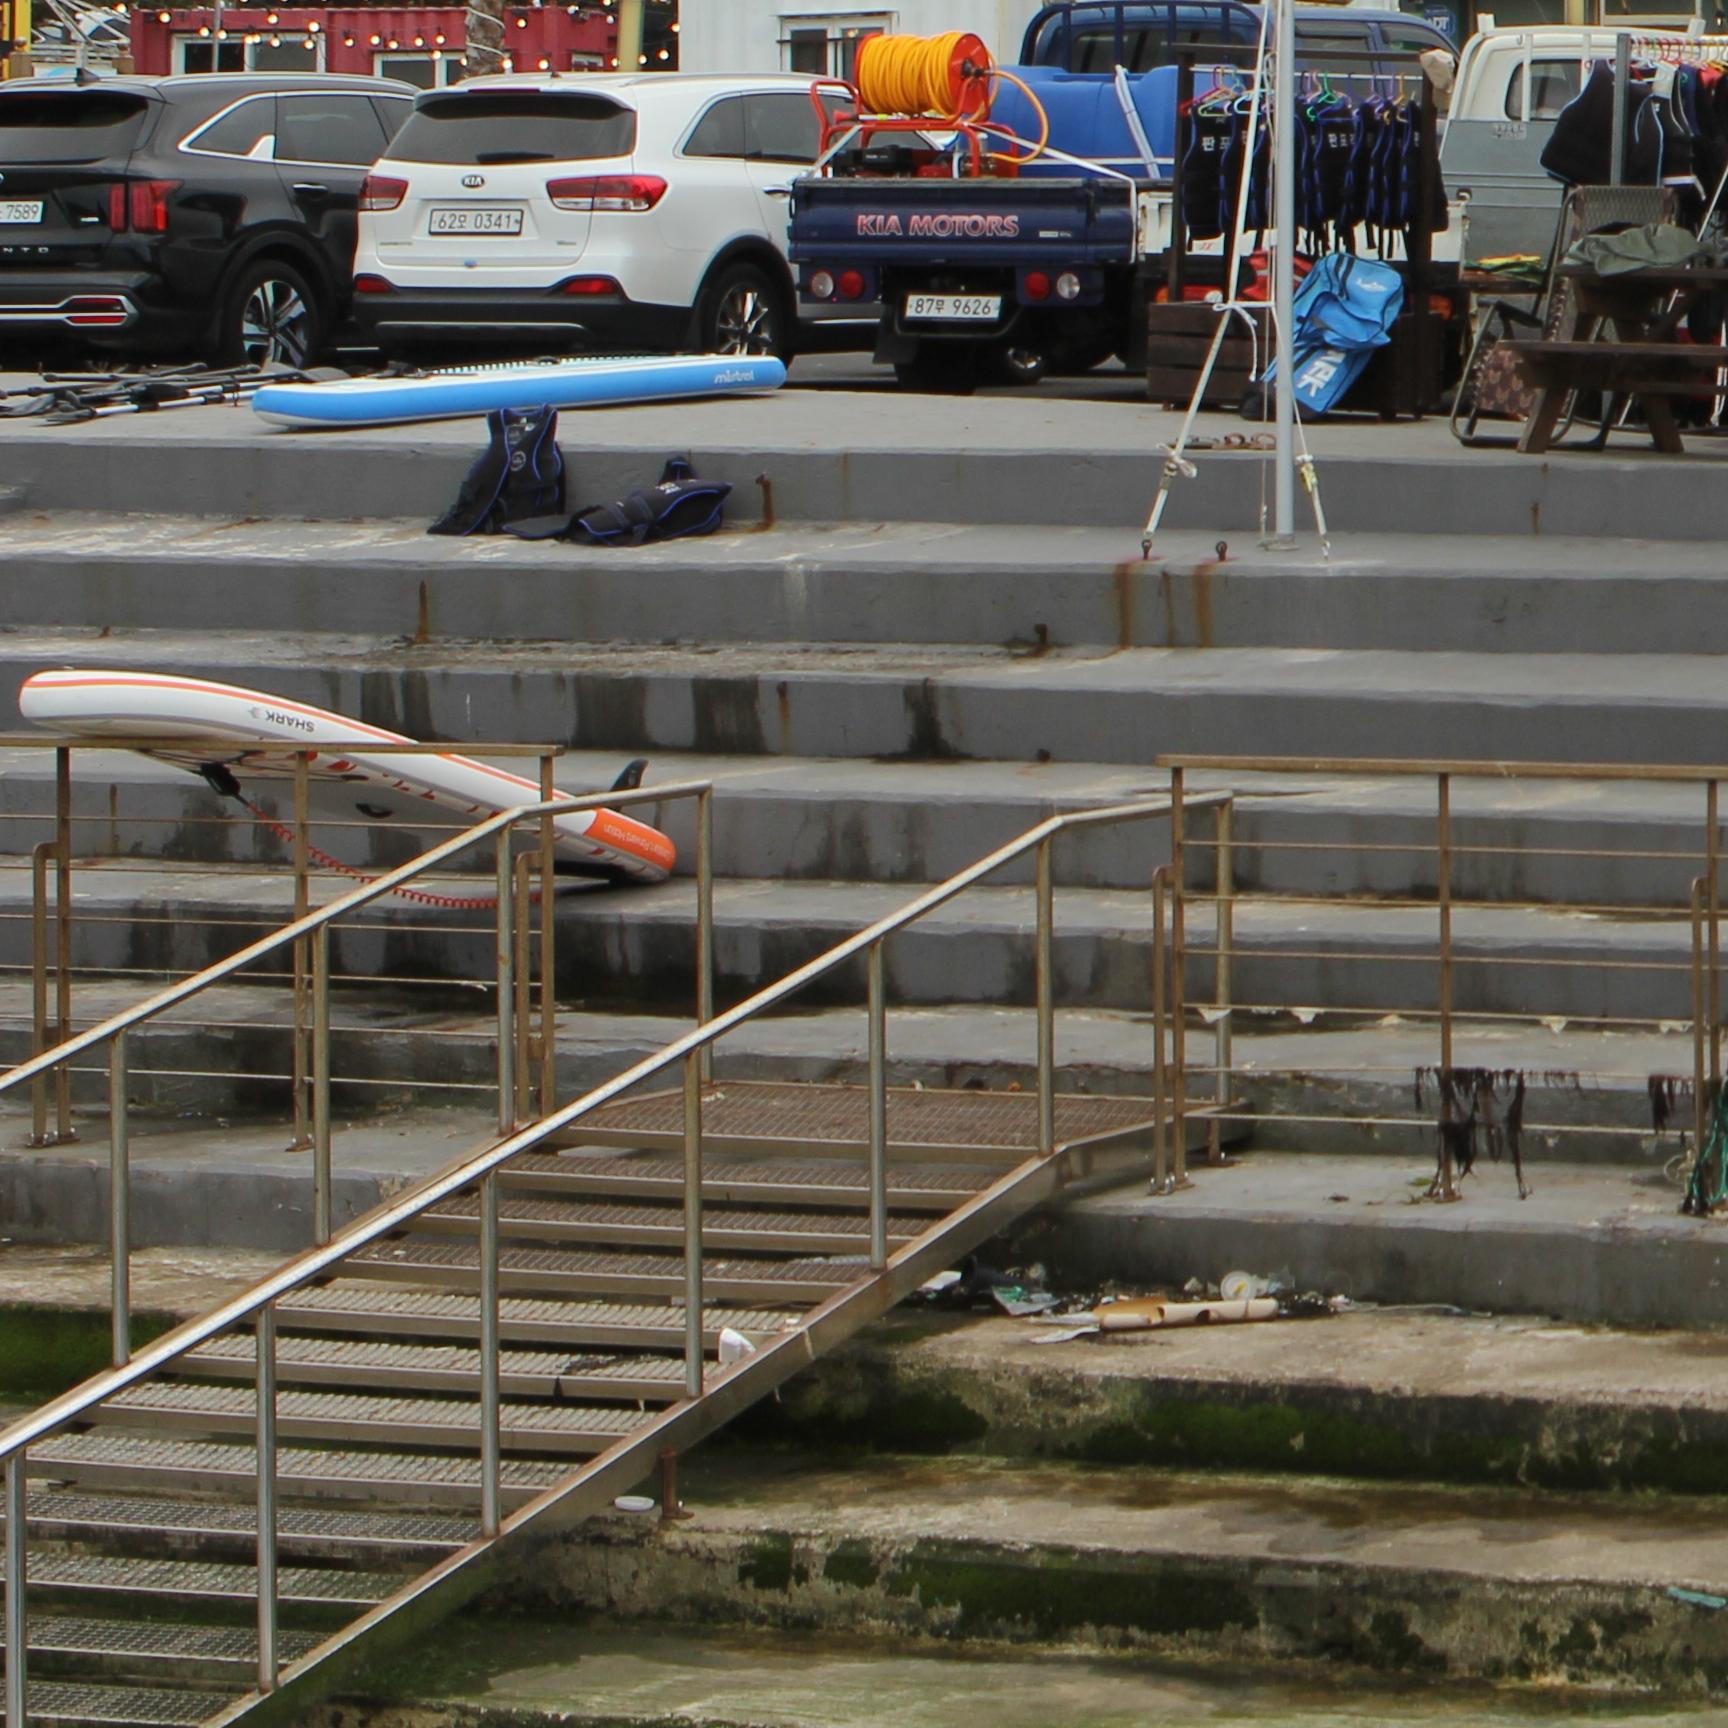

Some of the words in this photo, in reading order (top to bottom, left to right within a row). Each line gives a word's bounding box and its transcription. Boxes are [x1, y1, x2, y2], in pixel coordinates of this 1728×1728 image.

[463, 175, 483, 187] KIA
[6, 204, 40, 220] 7589
[473, 213, 513, 230] 0341
[857, 214, 903, 236] KIA
[908, 214, 1020, 237] MOTORS
[952, 298, 992, 316] 9626
[713, 368, 756, 385] mistral
[265, 709, 316, 733] SHARK
